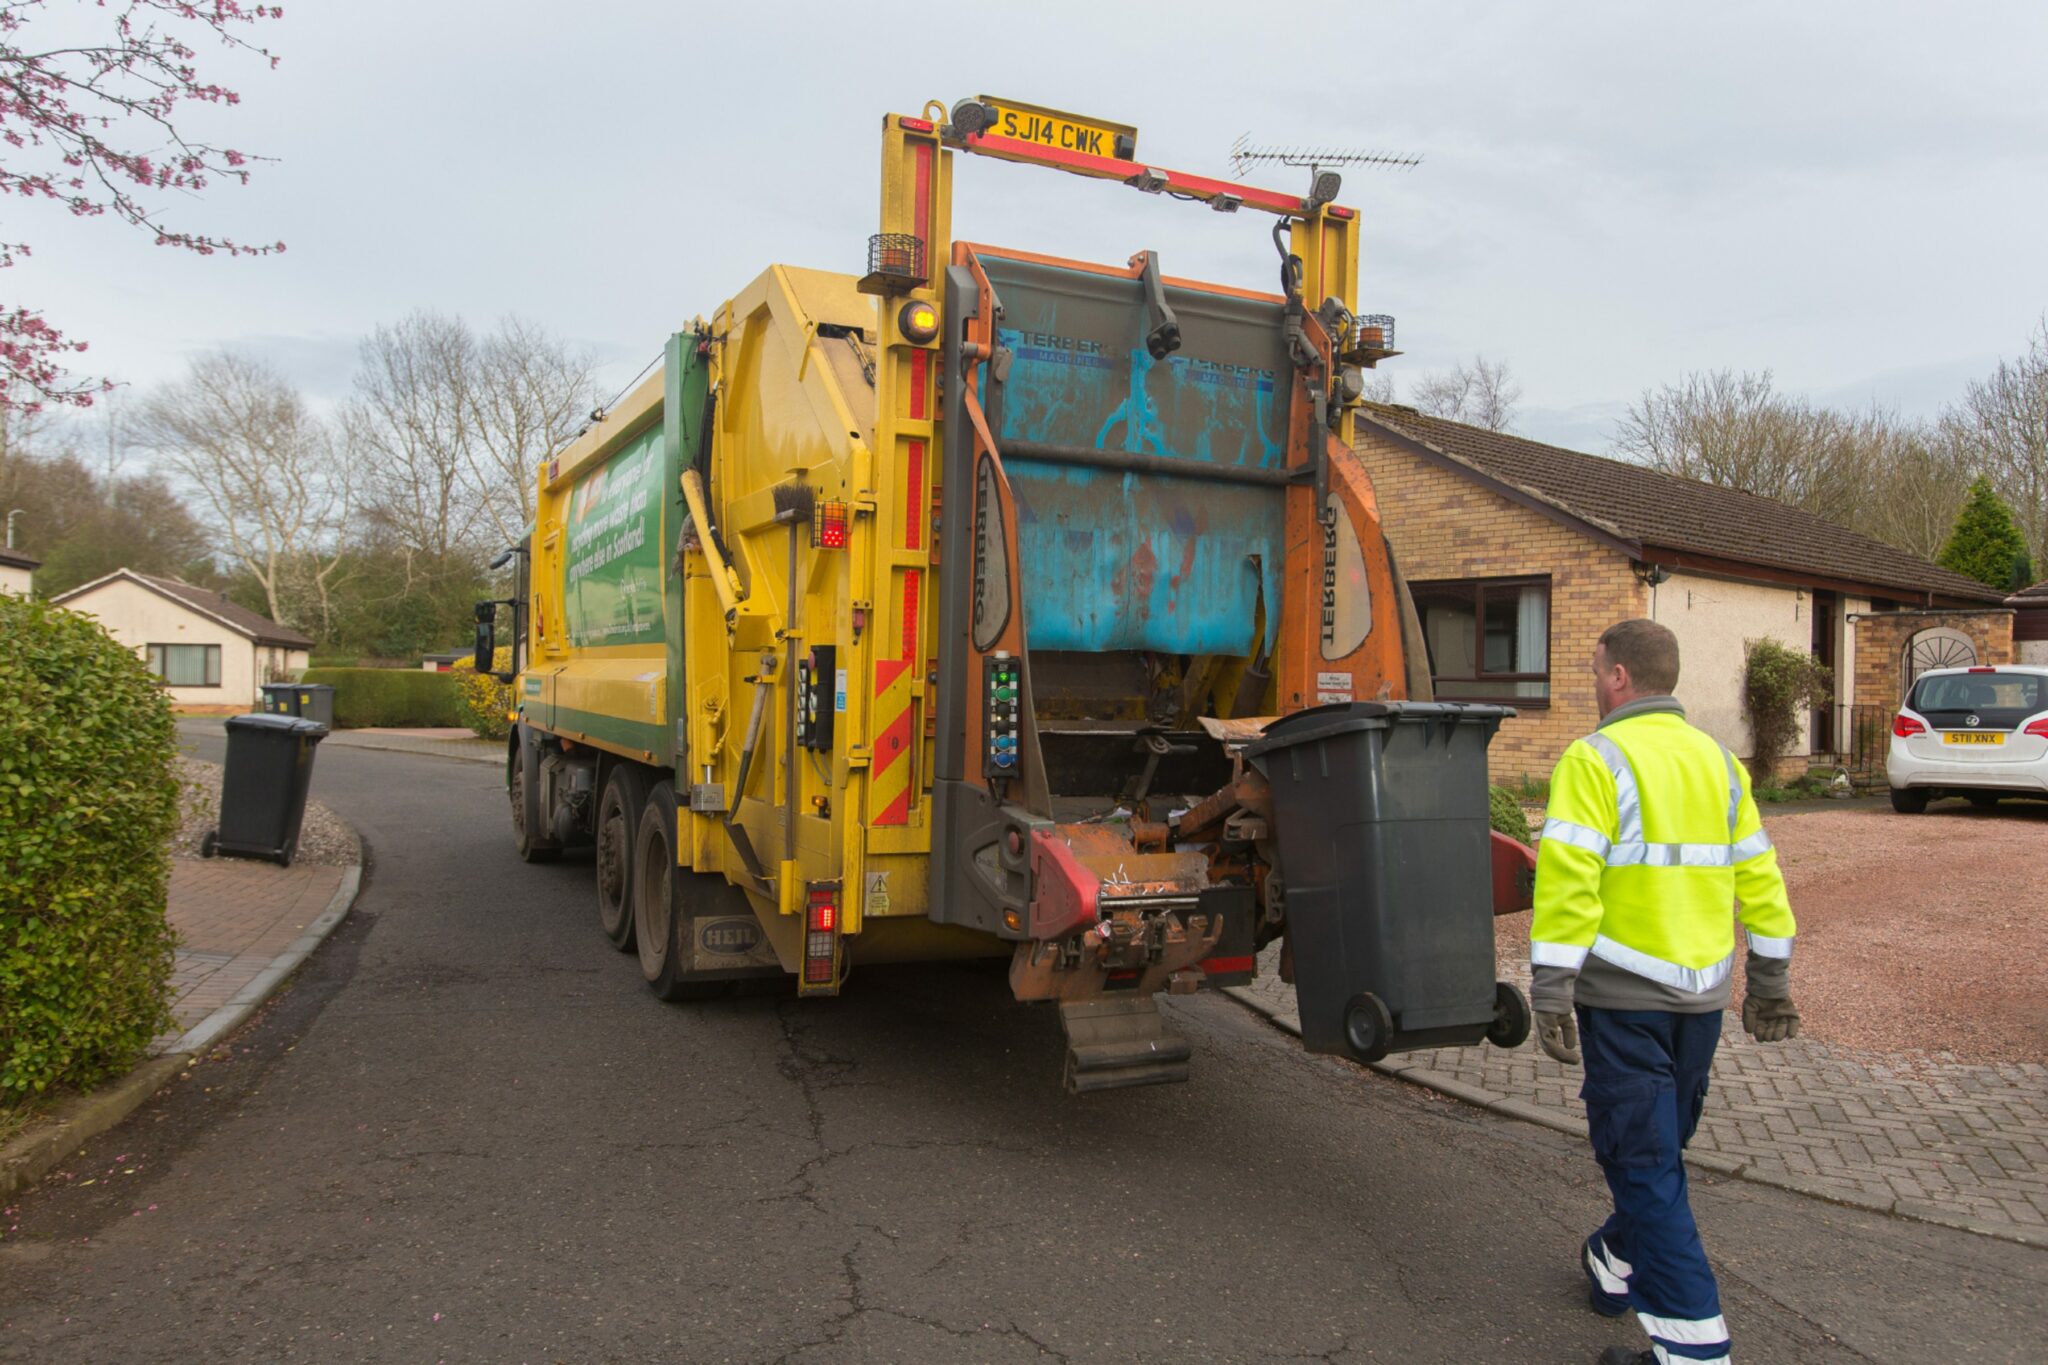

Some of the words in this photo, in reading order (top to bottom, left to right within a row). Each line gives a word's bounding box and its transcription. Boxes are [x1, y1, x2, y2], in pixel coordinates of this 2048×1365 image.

[1004, 112, 1054, 144] SJ14
[1061, 124, 1103, 155] CWK
[975, 466, 988, 627] TERBERG
[1952, 733, 1971, 743] ST11
[1974, 733, 1996, 743] XNX
[706, 928, 756, 946] HEIL
